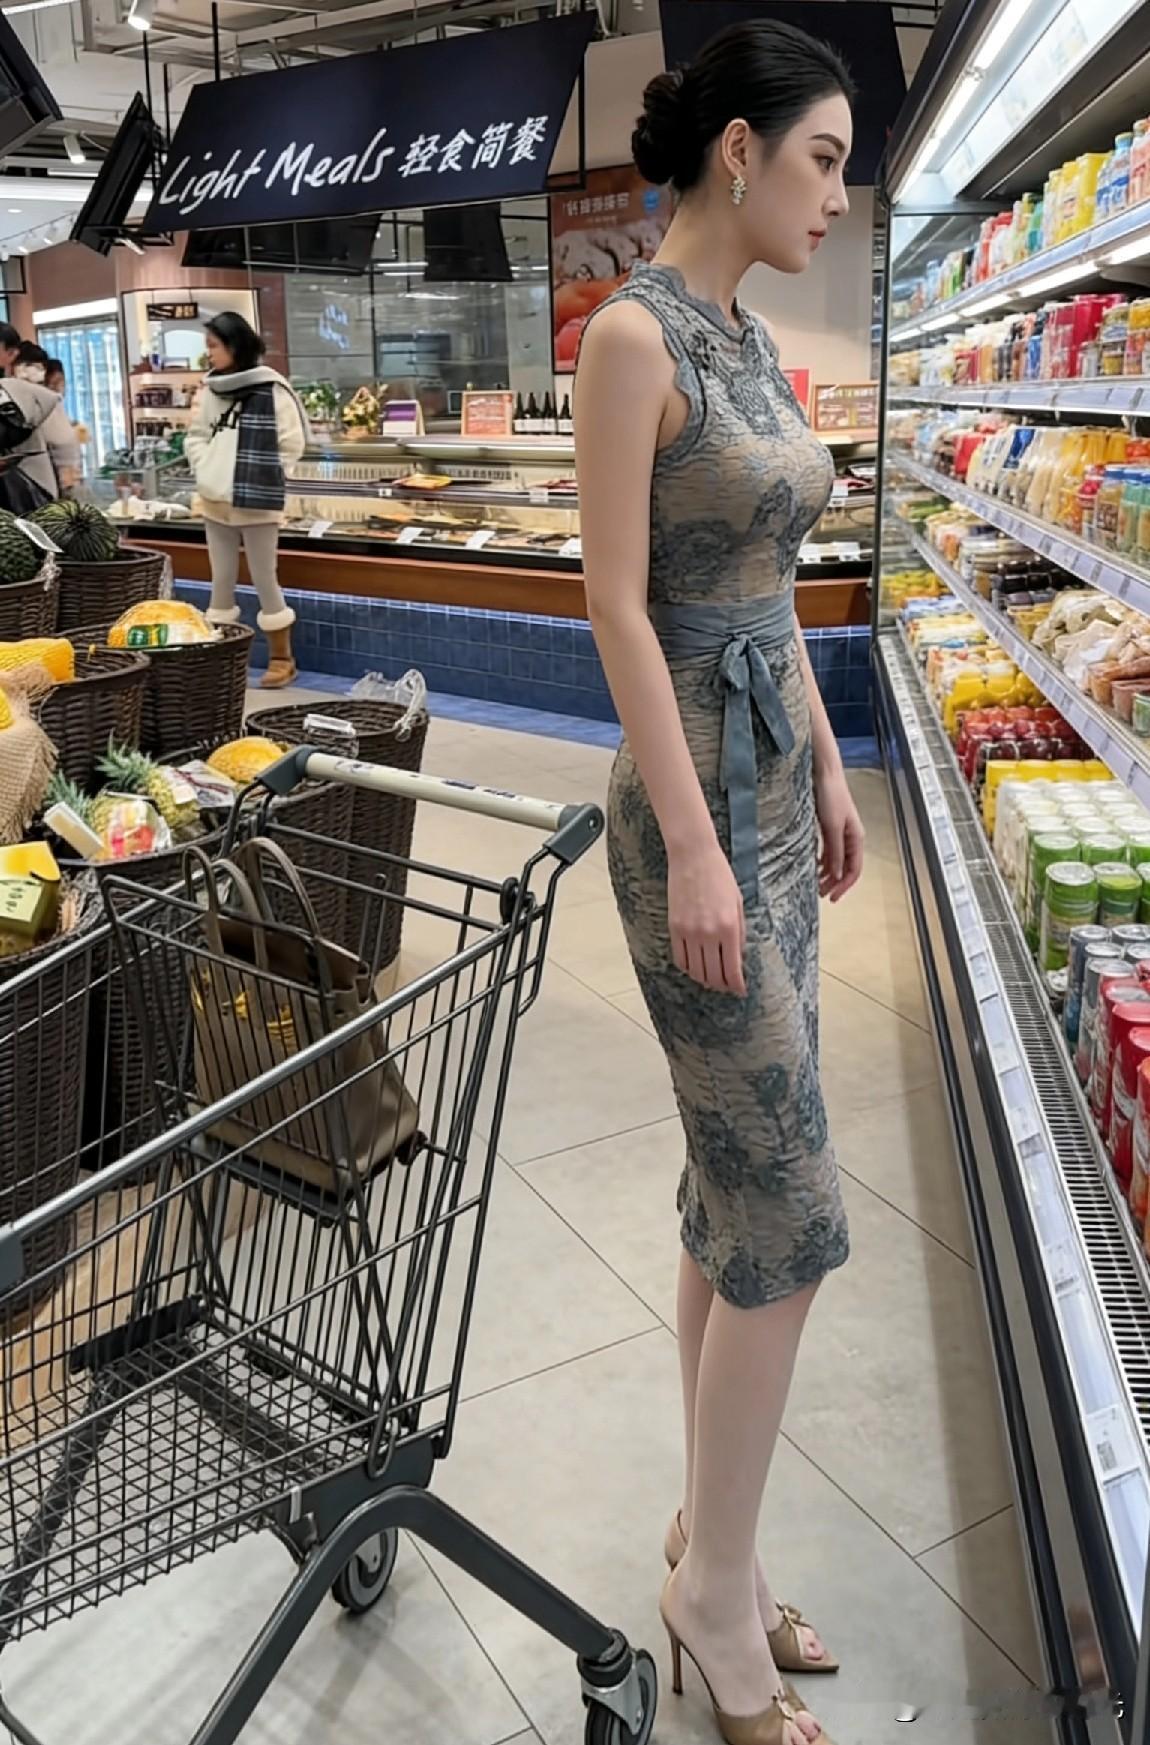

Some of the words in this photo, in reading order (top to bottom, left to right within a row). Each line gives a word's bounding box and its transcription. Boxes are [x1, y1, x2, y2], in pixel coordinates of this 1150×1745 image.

[158, 148, 266, 215] Light
[264, 127, 396, 196] Meals
[397, 115, 549, 180] 轻食简餐
